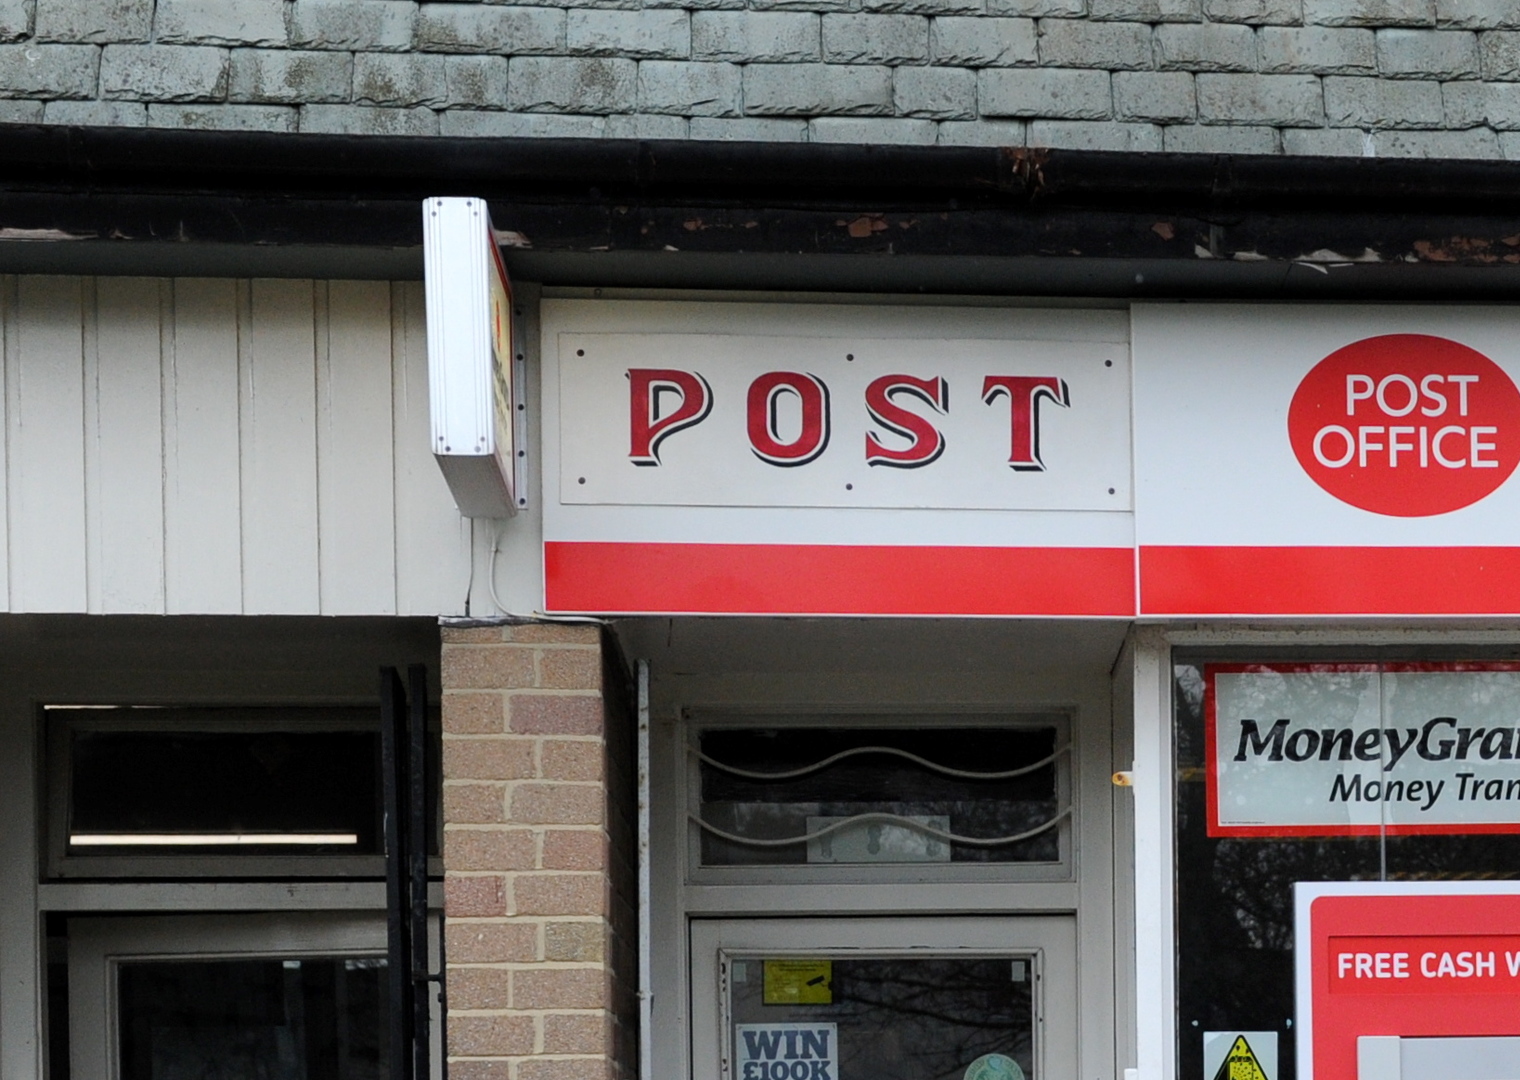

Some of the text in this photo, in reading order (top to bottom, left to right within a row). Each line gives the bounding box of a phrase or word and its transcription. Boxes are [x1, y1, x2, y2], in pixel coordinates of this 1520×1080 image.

[1345, 373, 1479, 417] POST
[625, 367, 1072, 473] POST
[1312, 424, 1498, 469] OFFICE
[1329, 772, 1445, 811] Money
[1337, 952, 1410, 979] FREE
[1420, 951, 1496, 978] CASH
[743, 1029, 830, 1060] WIN
